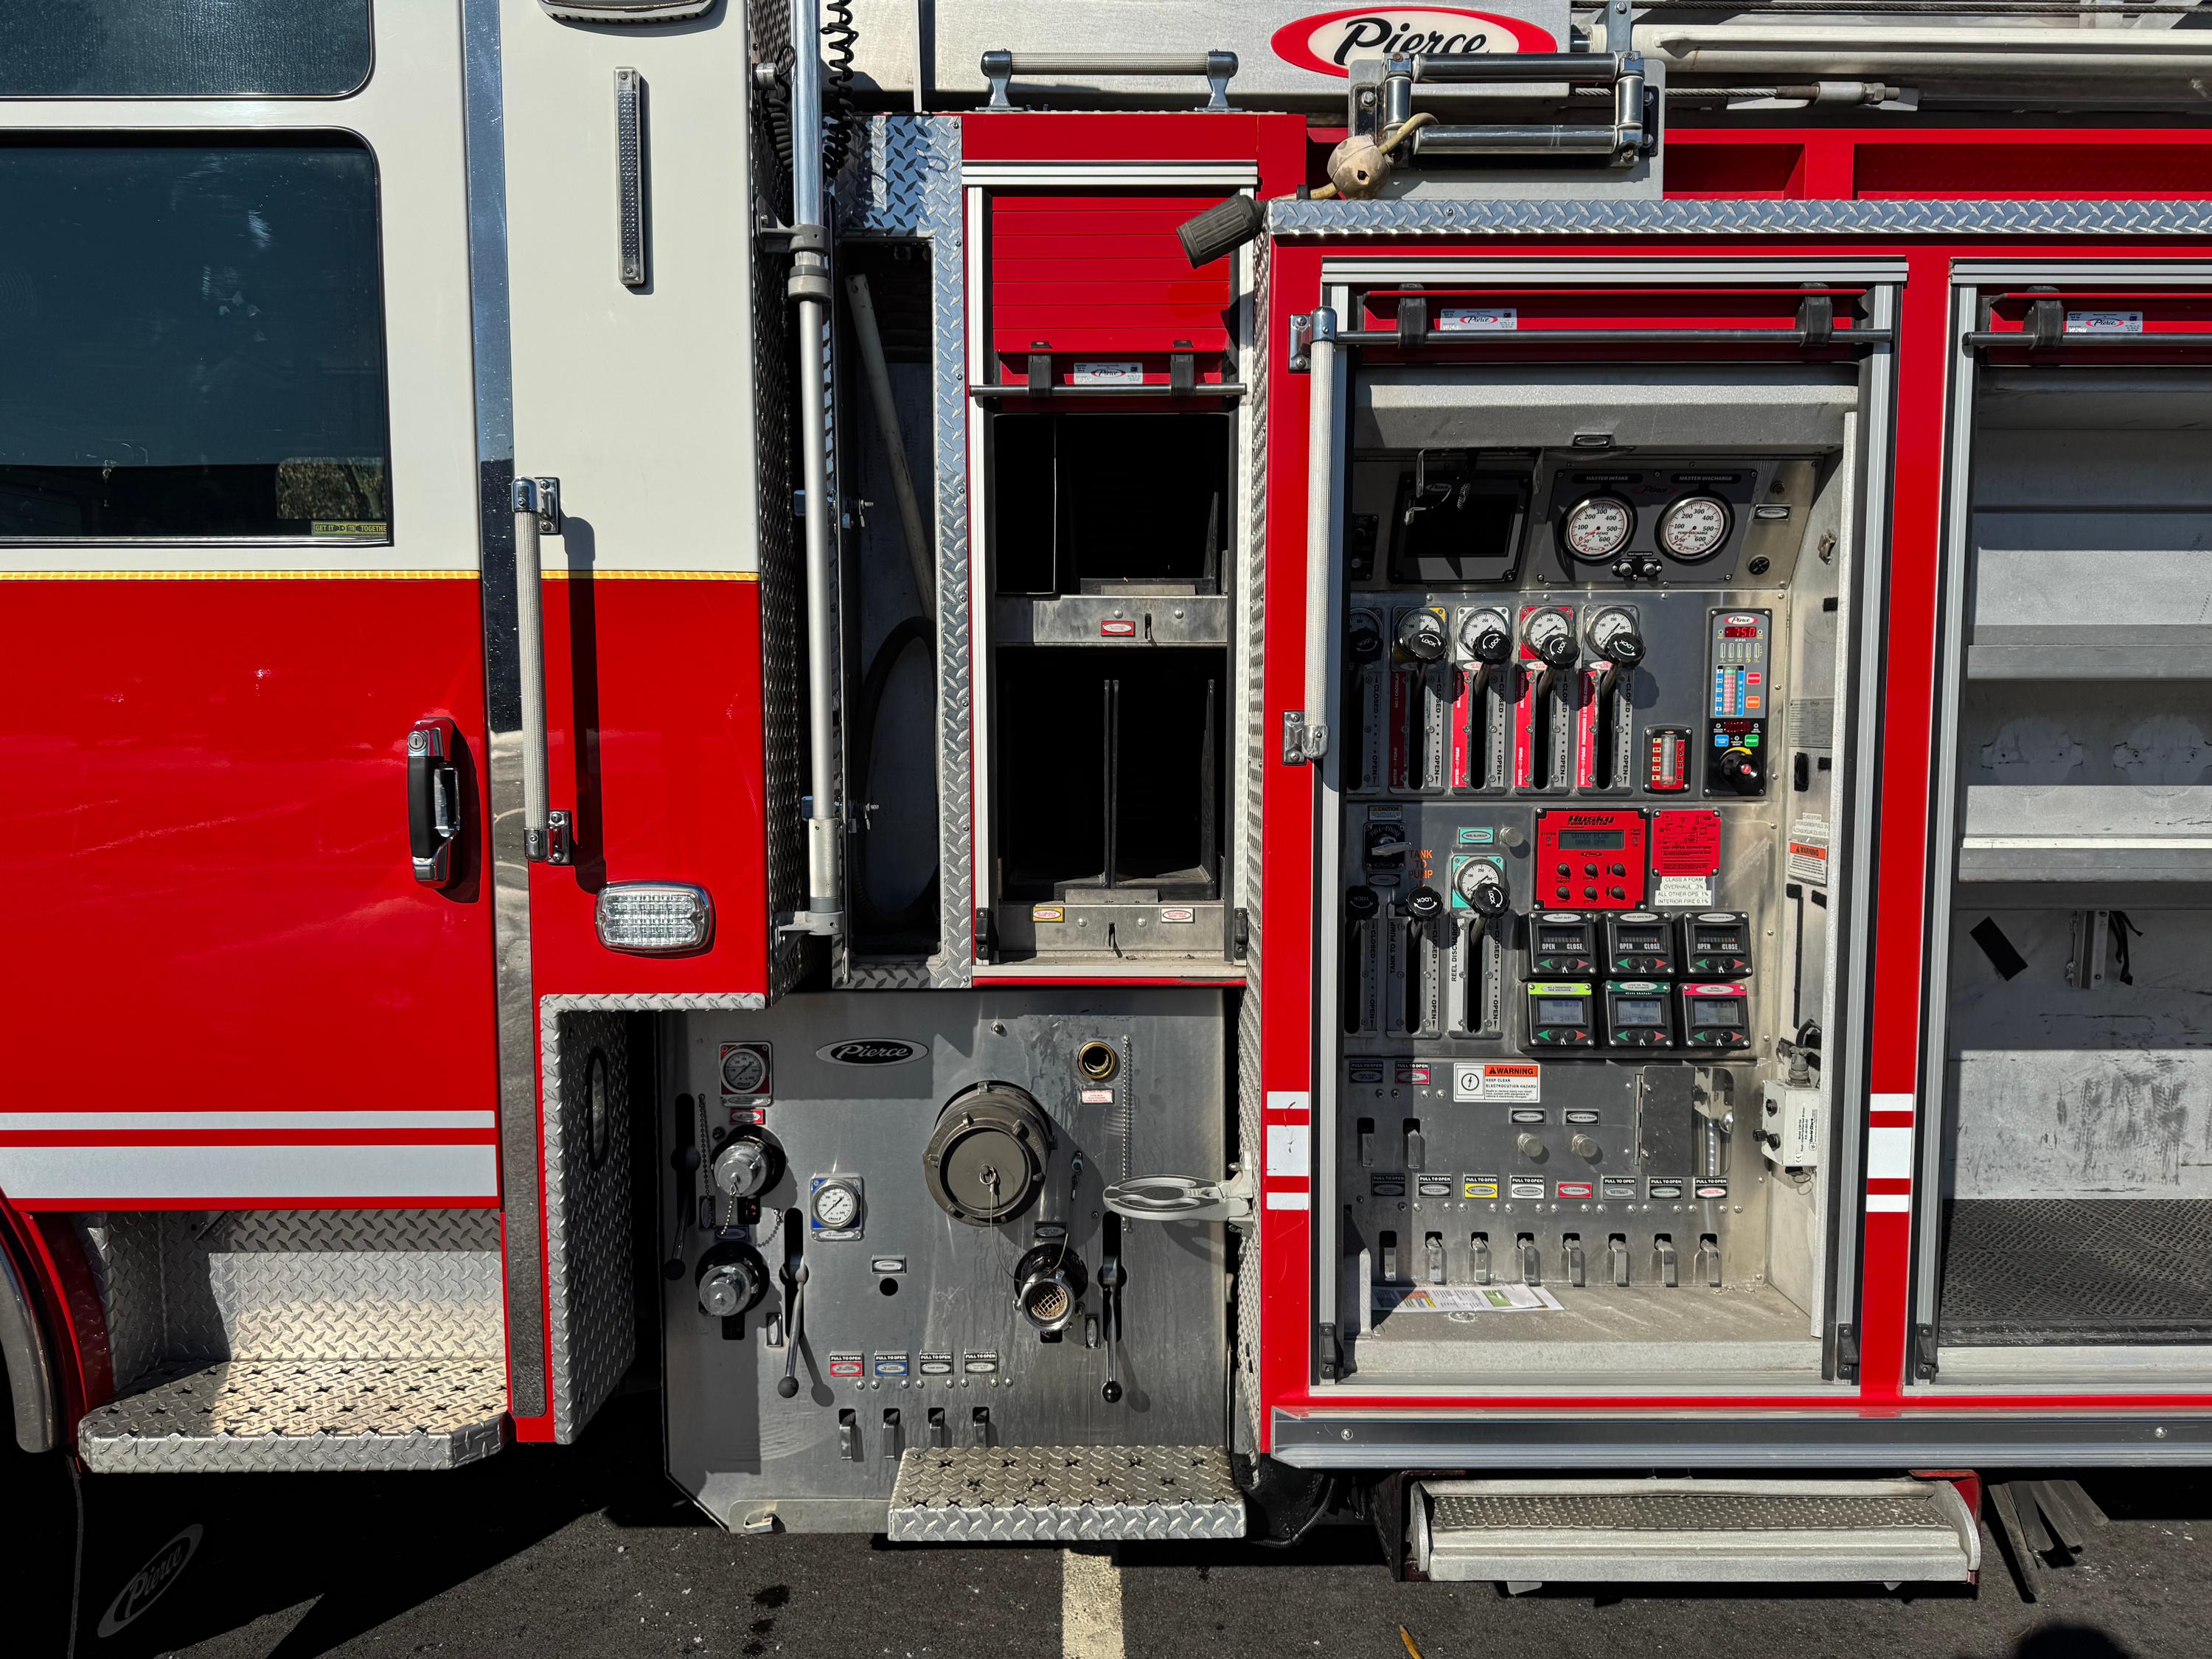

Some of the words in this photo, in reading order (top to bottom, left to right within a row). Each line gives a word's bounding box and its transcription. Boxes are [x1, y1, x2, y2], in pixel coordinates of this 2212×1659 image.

[1334, 17, 1490, 67] Pierce
[1467, 315, 1489, 324] Pierce
[2093, 318, 2121, 326] Pierce
[1731, 616, 1751, 625] Pierce
[1735, 627, 1756, 638] 750
[1421, 638, 1437, 647] LOCK
[1488, 637, 1501, 650] LOCK
[1556, 641, 1568, 654] LOCK
[1619, 639, 1635, 651] LOCK
[1568, 815, 1616, 824] Husky
[1409, 849, 1433, 859] TANK
[1800, 846, 1819, 857] WARNING
[1416, 860, 1428, 869] TO
[1408, 870, 1433, 879] PUMP
[1488, 890, 1497, 905] LOCK
[1390, 943, 1396, 953] TO
[836, 1044, 909, 1060] Pierce
[125, 1545, 184, 1619] Pierce
